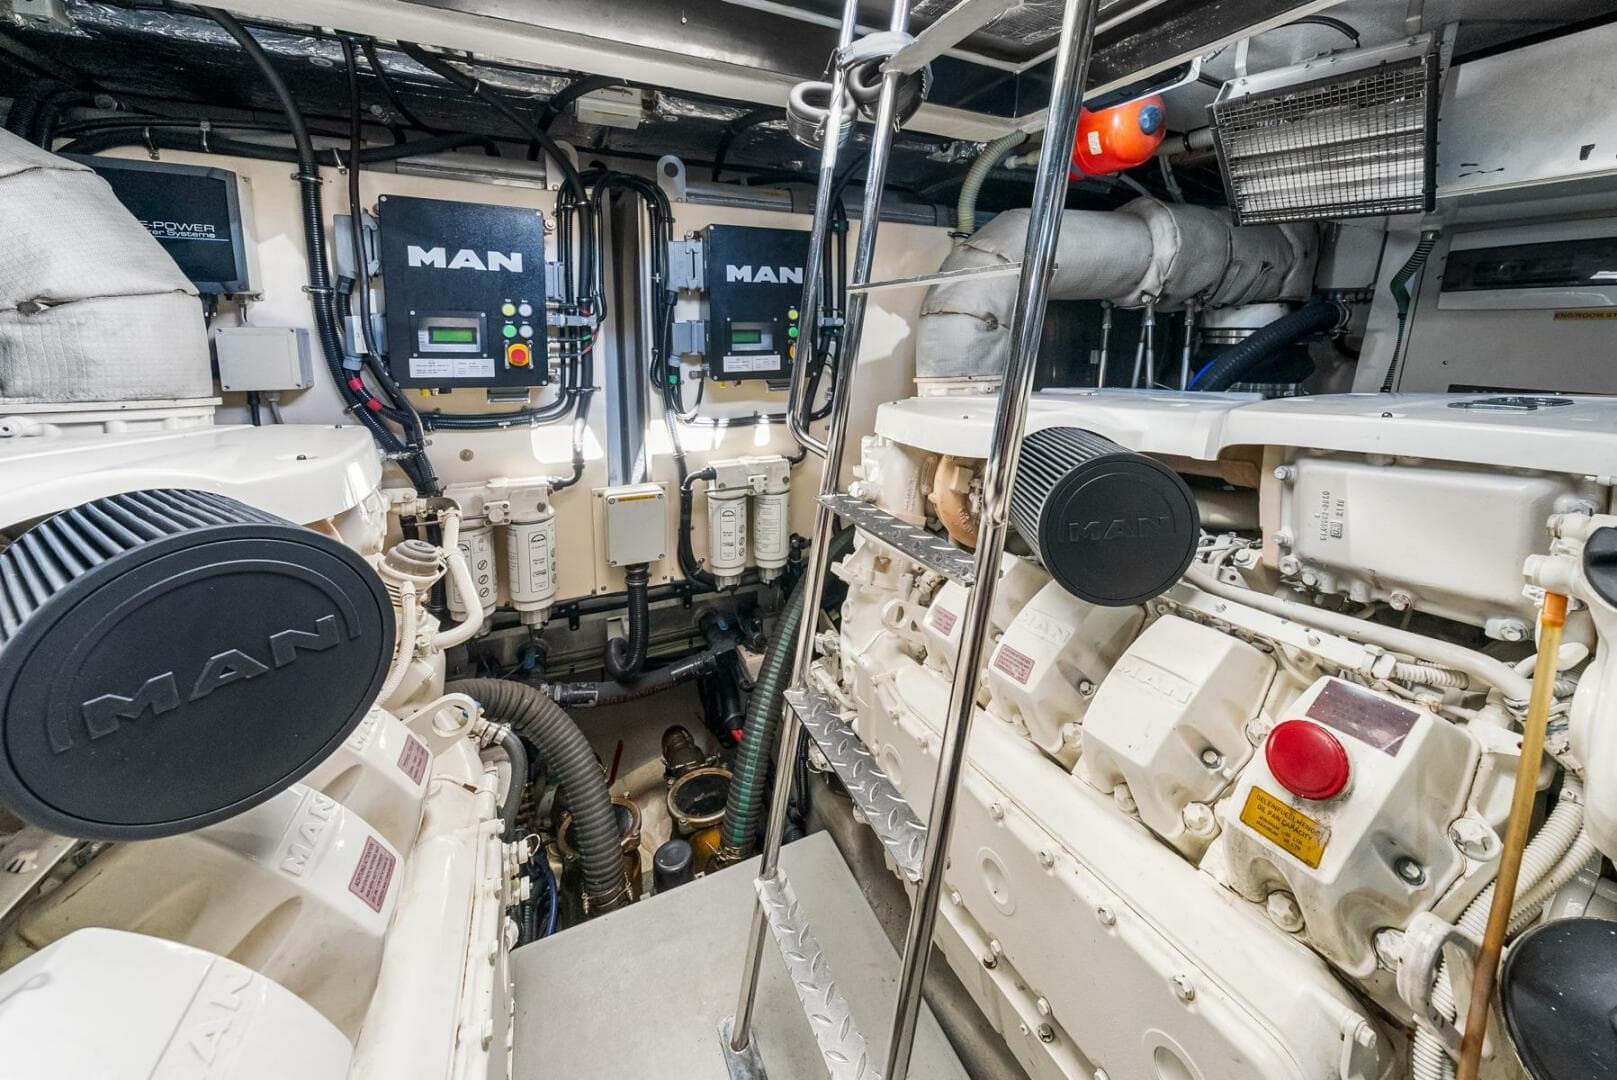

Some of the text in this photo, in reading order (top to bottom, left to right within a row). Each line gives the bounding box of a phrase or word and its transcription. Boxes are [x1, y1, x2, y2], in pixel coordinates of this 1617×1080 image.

[167, 230, 216, 239] Systems
[407, 245, 523, 273] MAN
[725, 263, 804, 285] MAN
[1069, 516, 1169, 542] MAN
[82, 613, 340, 740] MAN
[280, 794, 336, 877] MAN
